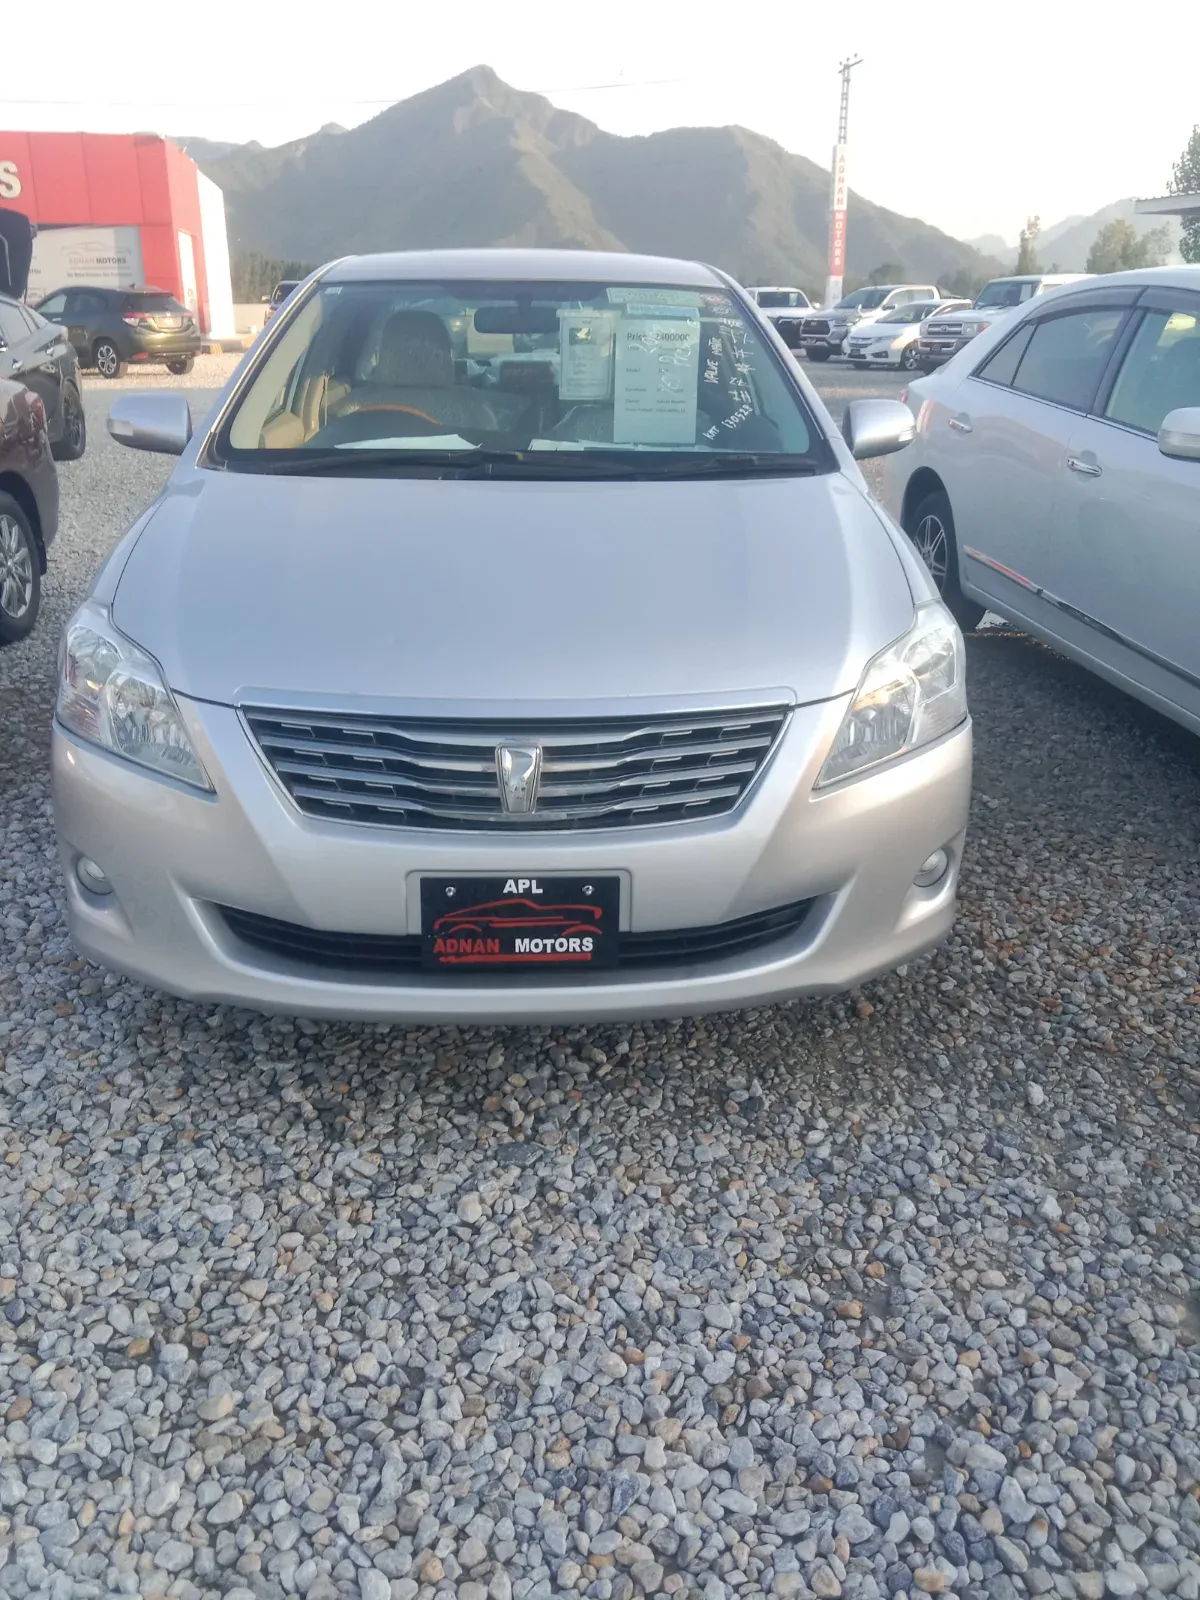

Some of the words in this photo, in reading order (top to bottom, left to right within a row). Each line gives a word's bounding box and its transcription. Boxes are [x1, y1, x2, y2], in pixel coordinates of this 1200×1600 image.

[836, 154, 846, 205] ADNAN
[834, 212, 845, 265] MOTORS
[503, 879, 543, 894] APL
[433, 938, 499, 954] ADNAN
[515, 937, 594, 954] MOTORS
